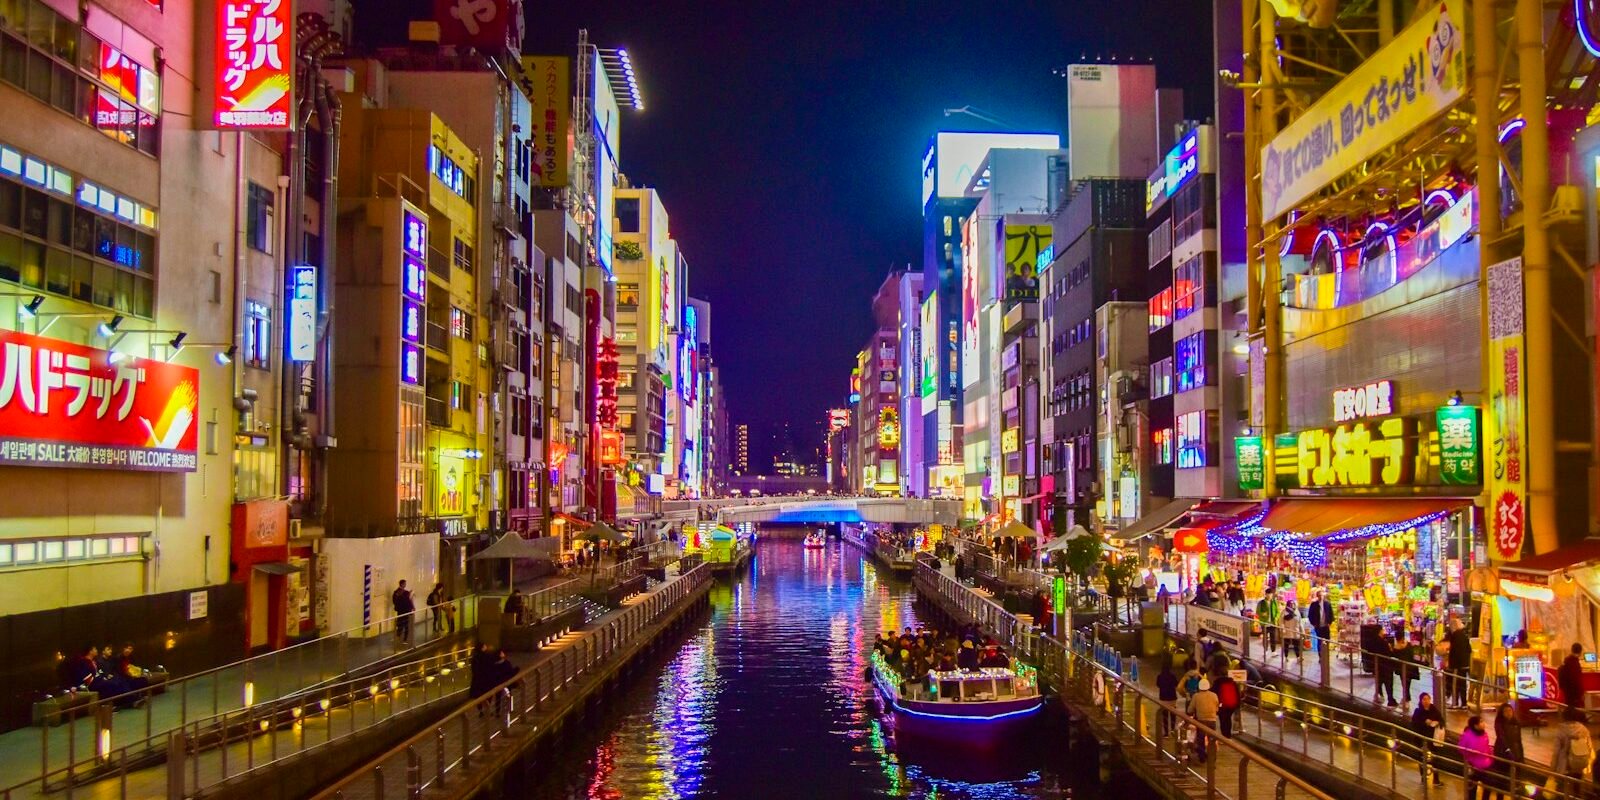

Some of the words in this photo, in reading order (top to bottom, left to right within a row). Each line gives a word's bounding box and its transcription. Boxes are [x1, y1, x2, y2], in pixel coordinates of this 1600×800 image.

[224, 4, 252, 91] ドラッグ
[0, 342, 146, 421] ハドラッグ
[1440, 417, 1472, 450] 薬
[38, 443, 65, 462] SALE
[129, 449, 171, 467] WELCOME
[1499, 500, 1519, 526] すぐ
[1499, 525, 1518, 549] そこ
